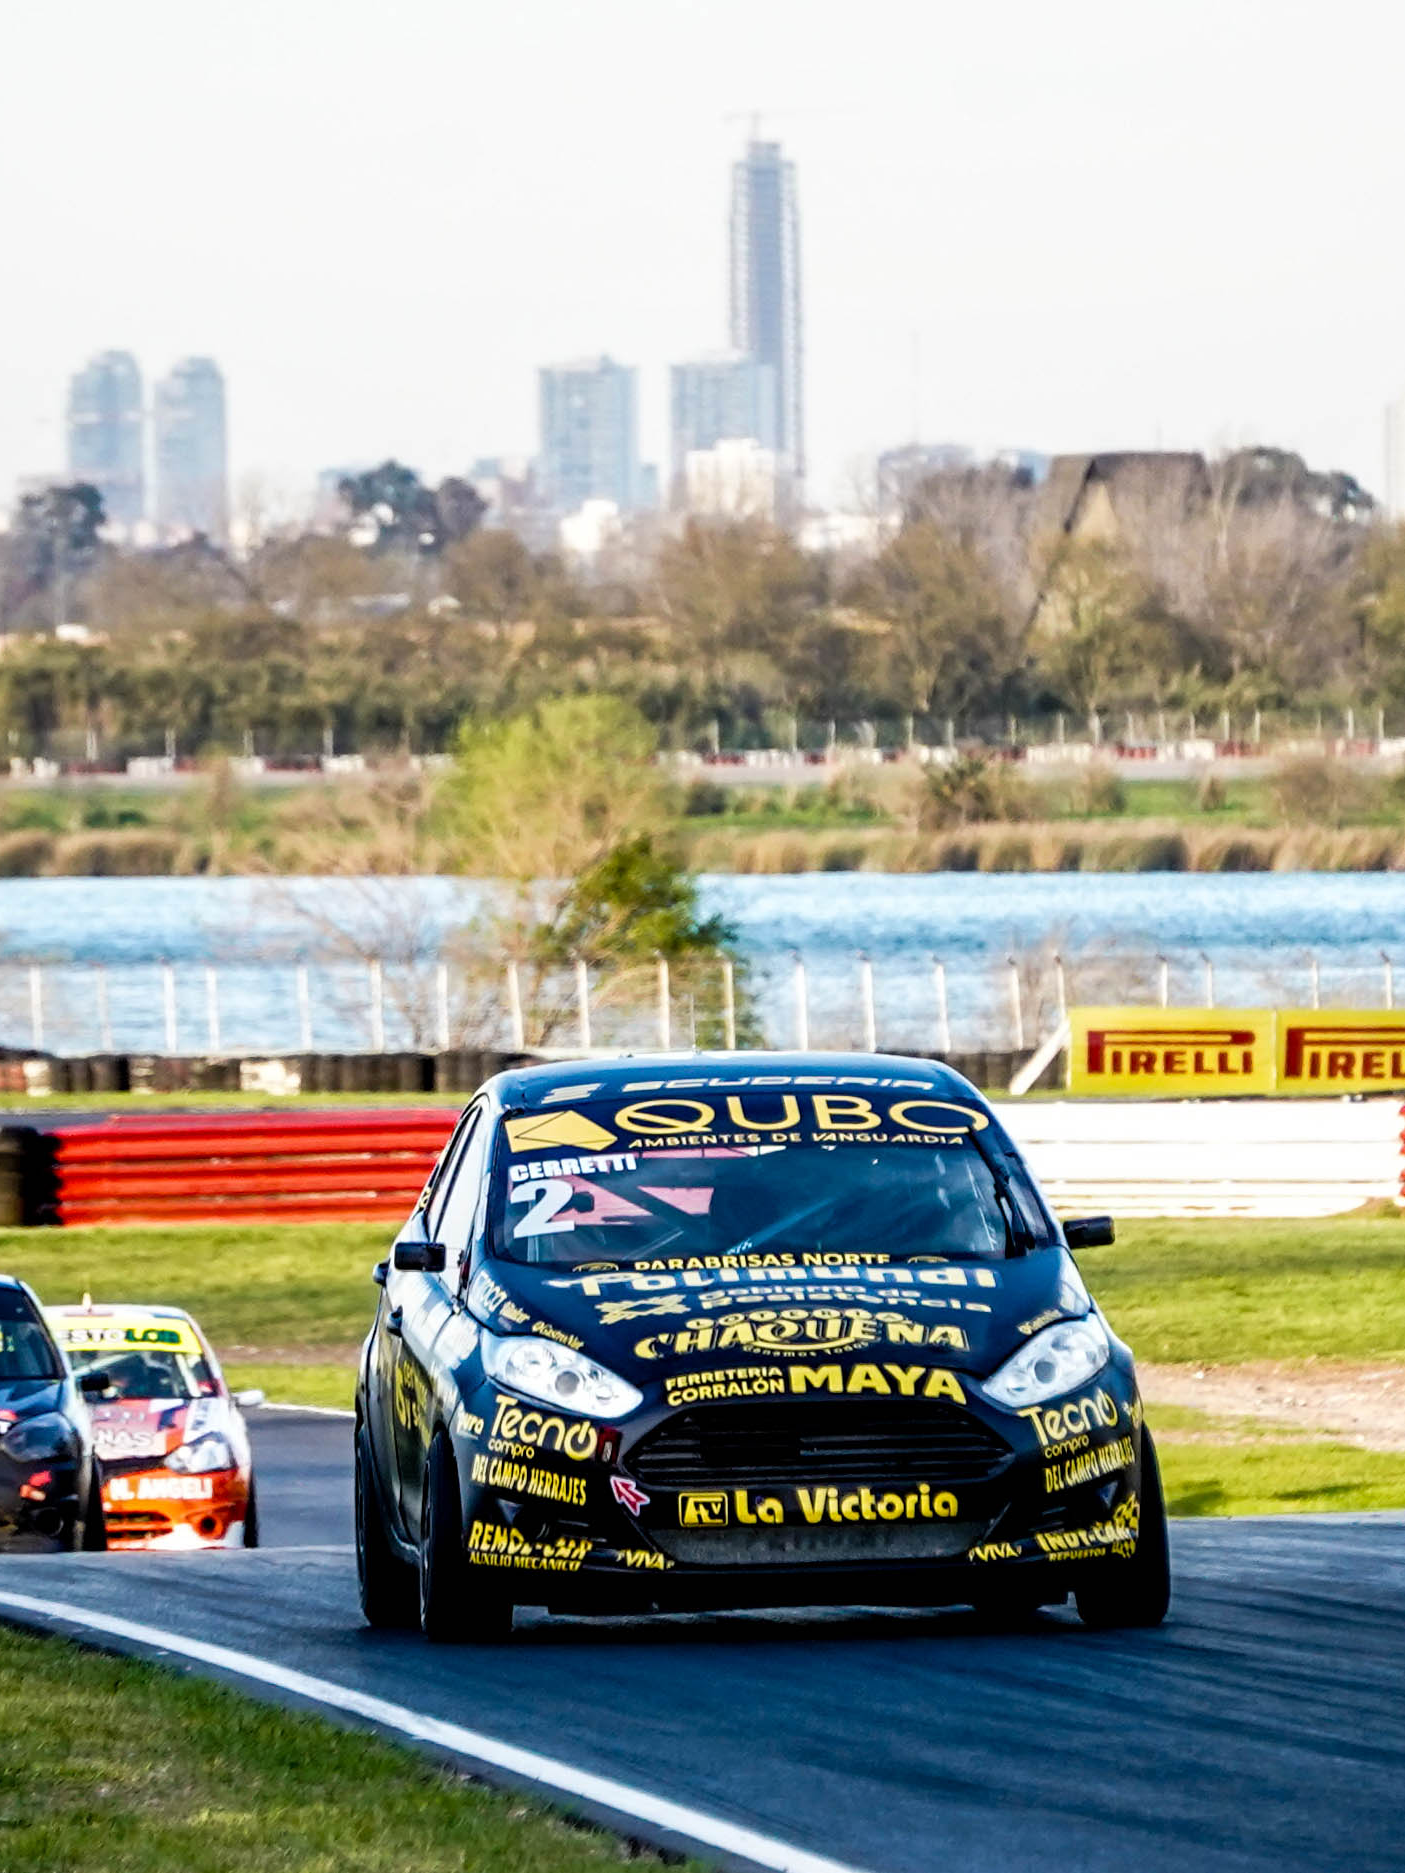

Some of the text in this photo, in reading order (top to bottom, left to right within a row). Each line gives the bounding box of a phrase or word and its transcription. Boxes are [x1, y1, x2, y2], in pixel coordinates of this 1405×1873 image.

[1087, 1030, 1256, 1075] PIRELLI
[621, 1075, 935, 1092] SCUDERIA
[614, 1094, 990, 1135] QUBO
[628, 1132, 964, 1149] AMBIENTES DE VANGUARDIA
[510, 1153, 637, 1182] CERRETTI
[510, 1179, 576, 1239] 2
[634, 1252, 797, 1272] PARABRISAS
[803, 1252, 891, 1267] NORTE
[665, 1363, 967, 1406] FERRETERIA MAYA
[667, 1378, 786, 1407] CORRALÓN
[488, 1438, 535, 1459] compro
[472, 1454, 587, 1506] DEL CAMPO HERRAJES
[1045, 1464, 1065, 1493] DEL
[1065, 1450, 1100, 1487] CAMPO
[735, 1489, 784, 1524] La
[797, 1482, 959, 1524] Victoria
[469, 1551, 513, 1568] AUXILIO
